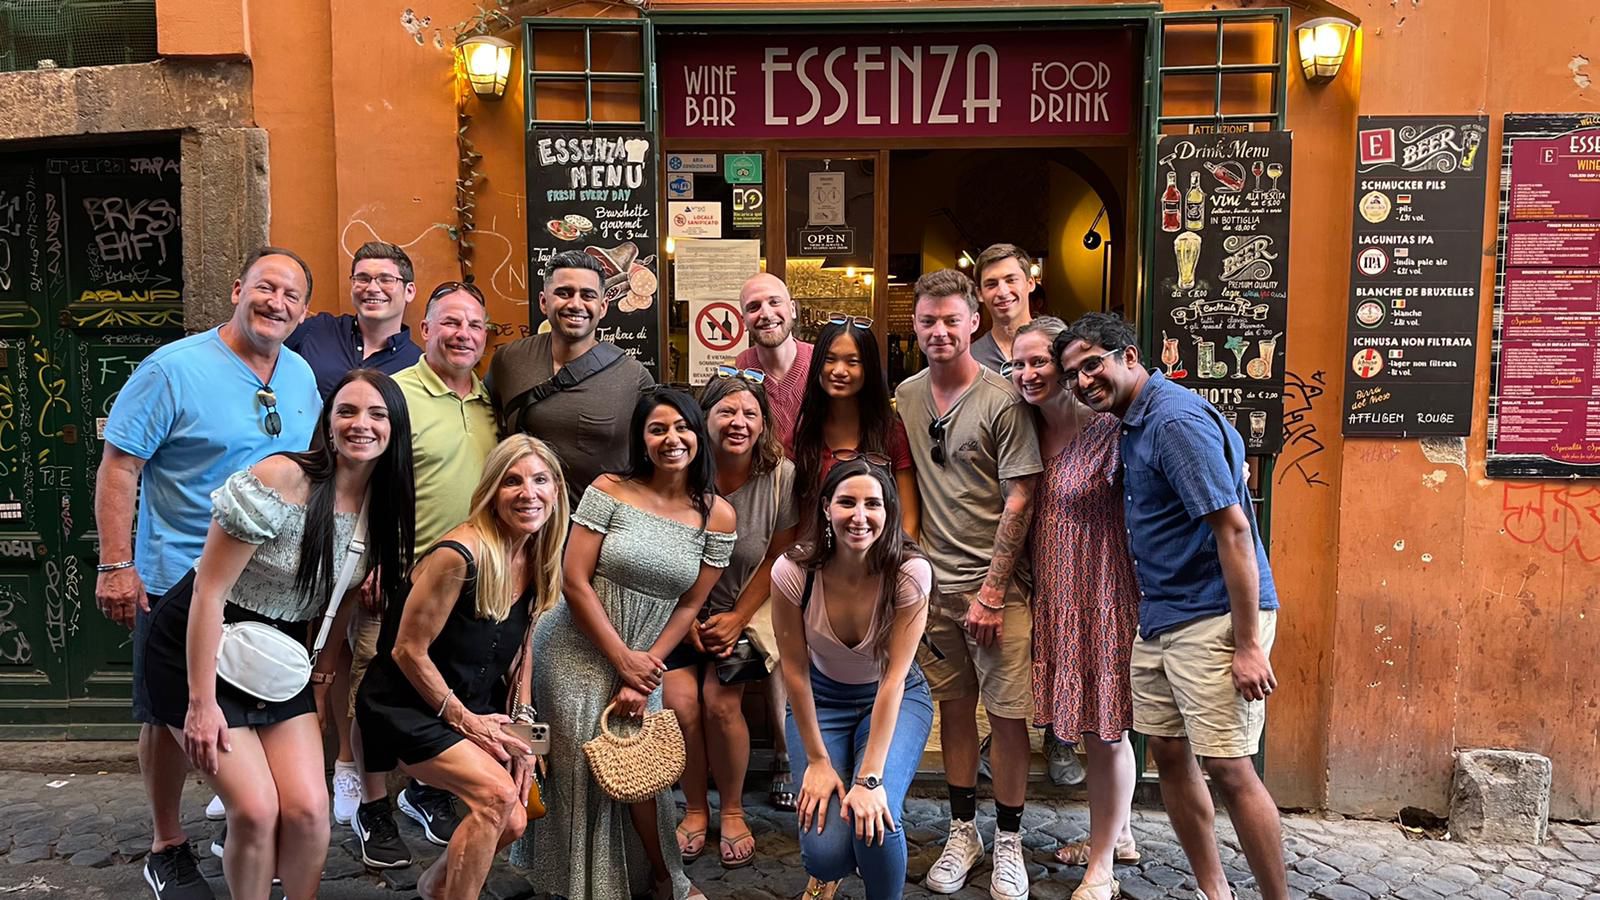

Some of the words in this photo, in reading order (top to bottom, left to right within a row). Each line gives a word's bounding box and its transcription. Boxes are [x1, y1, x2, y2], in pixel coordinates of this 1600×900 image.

[684, 65, 737, 95] WINE
[1031, 61, 1111, 92] FOOD
[761, 44, 1002, 126] ESSENZA
[685, 96, 737, 127] BAR
[1029, 92, 1110, 123] DRINK
[537, 136, 626, 166] ESSENZA
[1174, 138, 1226, 159] Drink
[1227, 140, 1270, 159] Menu
[1369, 135, 1384, 157] E
[1401, 128, 1465, 167] BEER
[1545, 150, 1554, 163] E
[1361, 181, 1424, 190] SCHMUCKER
[1426, 181, 1447, 190] PILS
[546, 189, 576, 202] FRESH
[580, 189, 609, 202] EVERY
[612, 189, 632, 202] DAY
[1210, 217, 1219, 225] IN
[1221, 215, 1261, 225] BOTTIGLIA
[600, 217, 642, 239] gourmet
[807, 234, 845, 244] OPEN
[1358, 235, 1416, 245] LAGUNITAS
[1417, 235, 1434, 245] IPA
[1222, 239, 1279, 274] BEER
[1363, 256, 1382, 269] IPA
[1228, 281, 1253, 289] PREMIUM
[1254, 281, 1279, 289] QUALITY
[1356, 287, 1403, 297] BLANCHE
[1405, 287, 1419, 297] DE
[1421, 287, 1475, 297] BRUXELLES
[1203, 302, 1237, 313] Cocktails
[1353, 338, 1399, 347] ICHNUSA
[1401, 338, 1425, 347] NON
[1427, 338, 1472, 347] FILTRATA
[1348, 412, 1405, 425] AFFLIGEM
[1416, 412, 1455, 425] ROUGE
